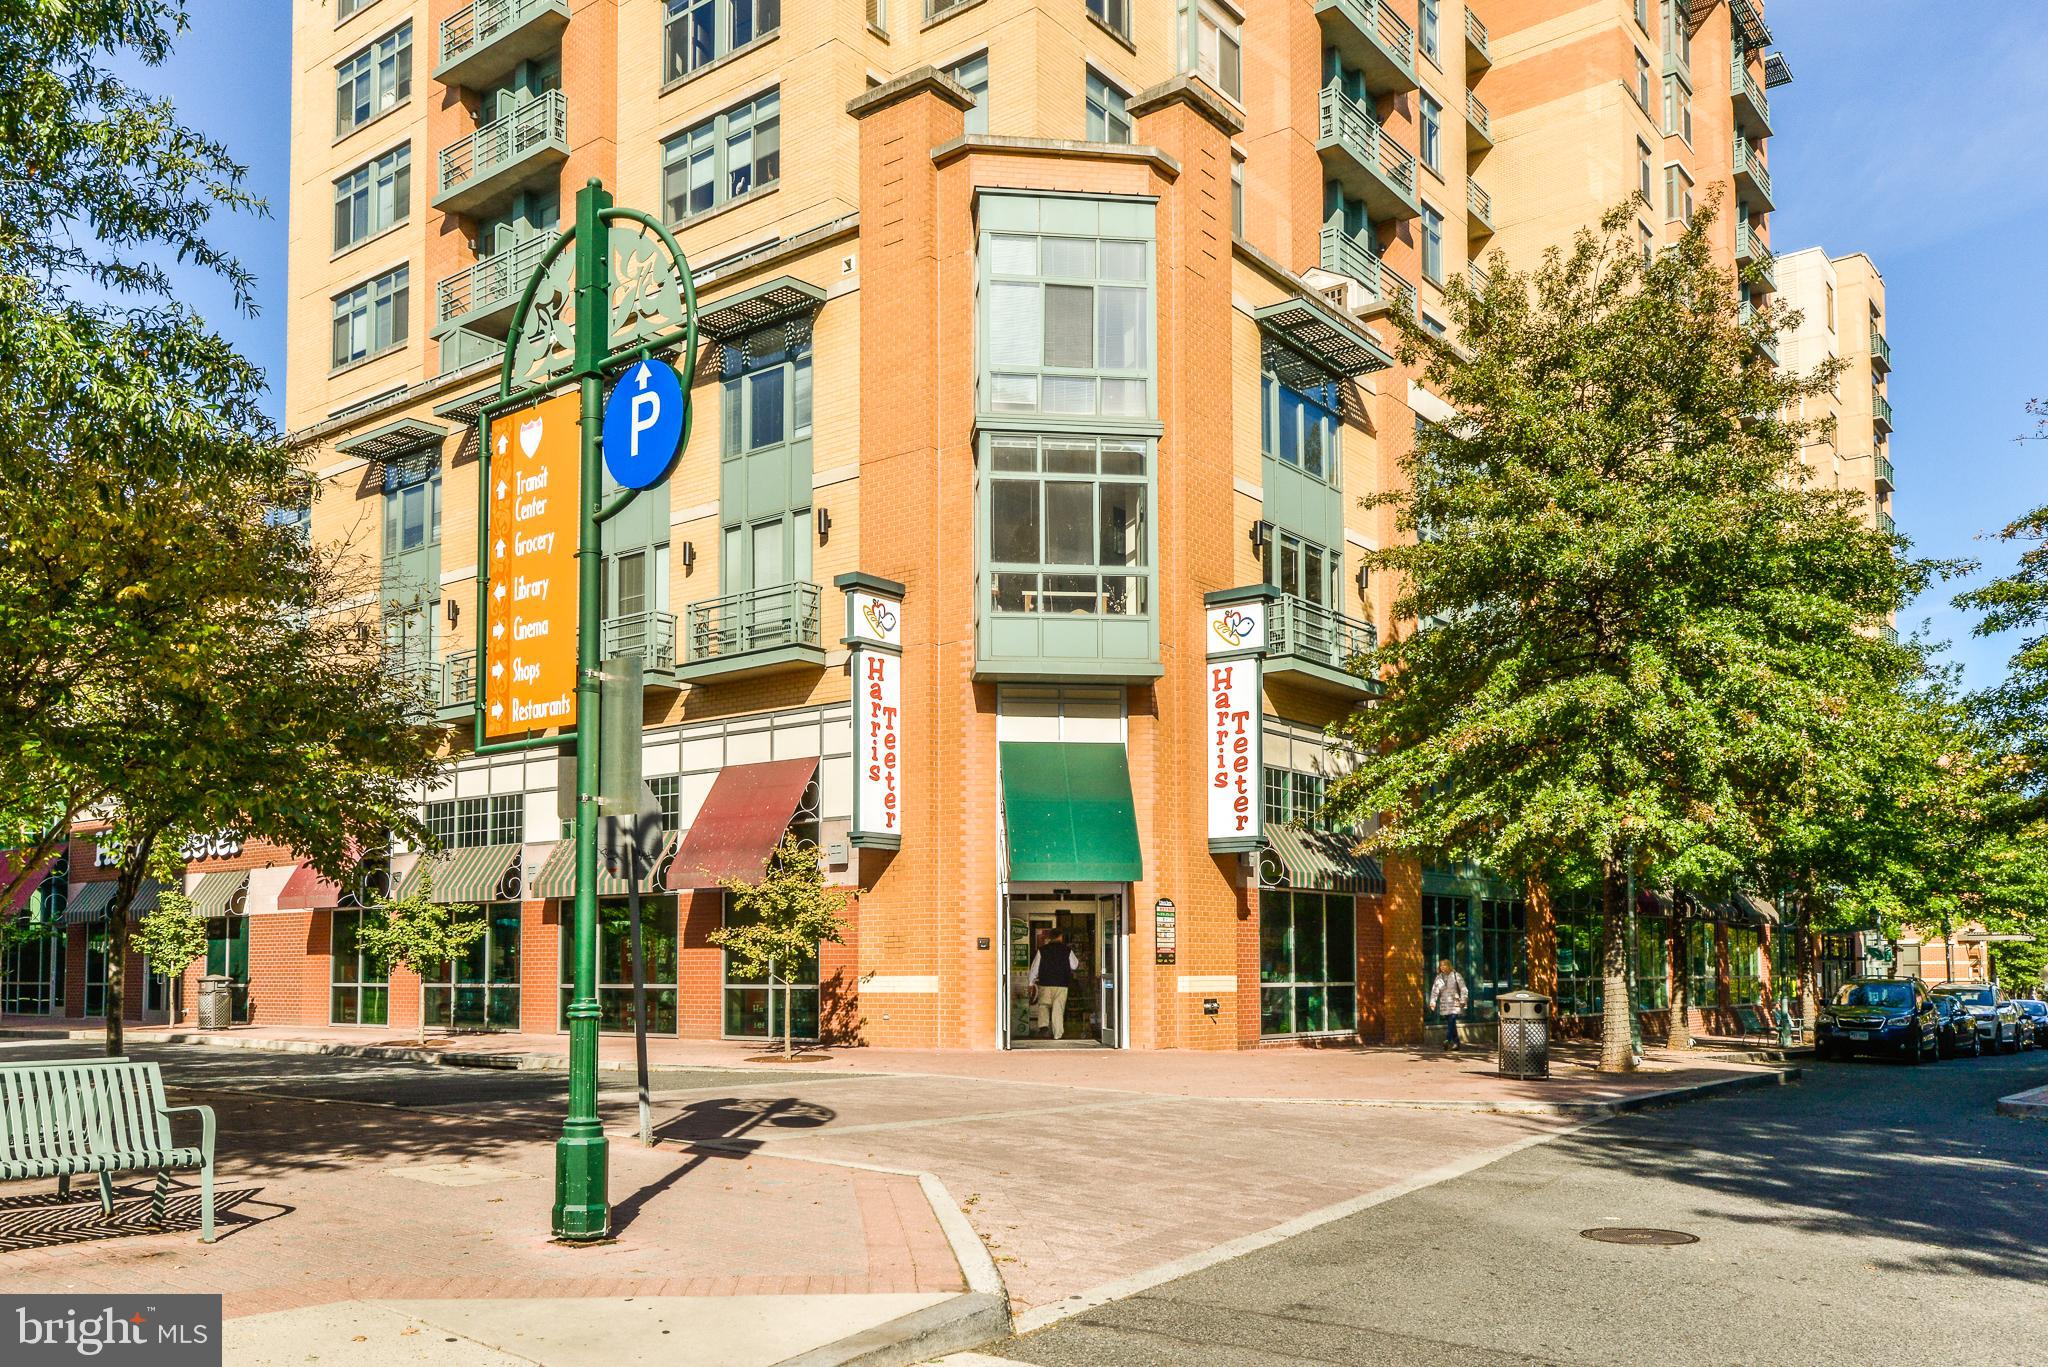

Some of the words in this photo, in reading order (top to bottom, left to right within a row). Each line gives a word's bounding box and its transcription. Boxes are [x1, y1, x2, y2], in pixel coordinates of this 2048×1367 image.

[631, 391, 660, 457] P
[516, 466, 548, 496] Transit
[515, 496, 547, 522] Center
[514, 531, 555, 557] Grocery
[513, 575, 549, 601] Library
[513, 616, 549, 641] Cinema
[512, 657, 540, 685] Shops
[512, 693, 570, 722] Restaurants
[868, 657, 885, 782] Harris
[883, 706, 897, 828] Teeter
[1212, 667, 1233, 788] Harris
[1231, 711, 1250, 831] Teeter
